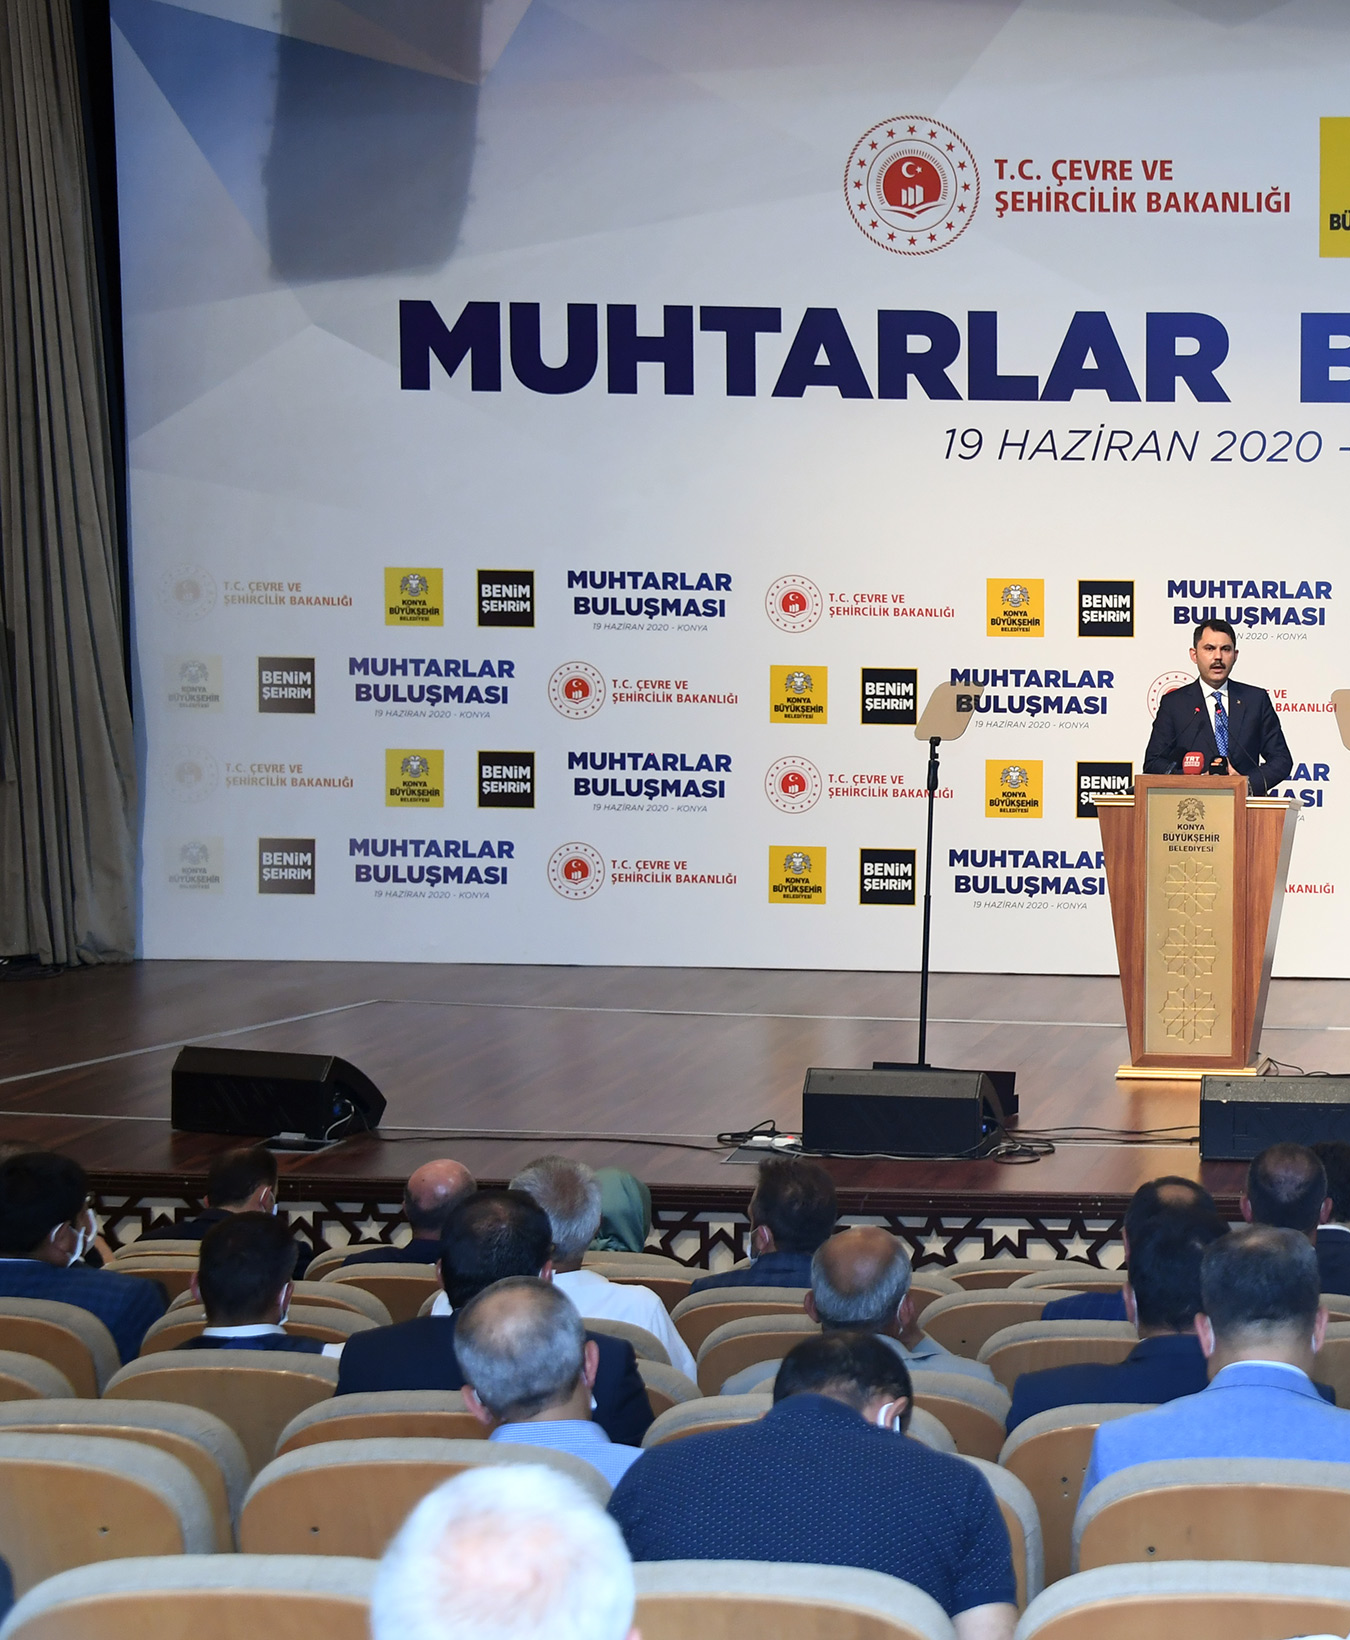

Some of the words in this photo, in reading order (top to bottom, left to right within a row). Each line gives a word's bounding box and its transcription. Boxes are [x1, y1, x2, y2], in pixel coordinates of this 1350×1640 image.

[994, 159, 1041, 180] T.C.
[1052, 160, 1132, 183] ÇEVRE
[1142, 160, 1173, 180] VE
[995, 185, 1136, 217] ŞEHİRCİLİK
[1147, 186, 1290, 213] BAKANLIĞI
[399, 300, 1231, 402] MUHTARLAR
[946, 429, 982, 460] 19
[998, 423, 1199, 461] HAZİRAN
[1211, 431, 1322, 462] 2020
[568, 570, 732, 591] MUHTARLAR
[1168, 580, 1332, 600] MUHTARLAR
[574, 595, 725, 619] BULUŞMASI
[829, 593, 849, 602] T.C.
[853, 593, 887, 605] ÇEVRE
[891, 594, 904, 603] VE
[829, 604, 889, 618] ŞEHİRCİLİK
[894, 607, 954, 617] BAKANLIĞI
[349, 658, 514, 678] MUHTARLAR
[612, 680, 632, 689] T.C.
[636, 680, 671, 692] ÇEVRE
[675, 681, 688, 690] VE
[951, 669, 1114, 688] MUHTARLAR
[355, 683, 508, 706] BULUŞMASI
[612, 692, 672, 704] ŞEHİRCİLİK
[677, 693, 737, 704] BAKANLIĞI
[1274, 689, 1287, 699] VE
[957, 694, 1107, 716] BULUŞMASI
[1275, 701, 1337, 713] BAKANLIĞI
[986, 720, 1026, 728] HAZİRAN
[568, 752, 732, 773] MUHTARLAR
[575, 777, 725, 801] BULUŞMASI
[829, 774, 849, 783] T.C.
[852, 774, 886, 786] ÇEVRE
[890, 775, 903, 784] VE
[829, 786, 888, 798] ŞEHİRCİLİK
[349, 839, 514, 859] MUHTARLAR
[355, 864, 508, 887] BULUŞMASI
[611, 860, 631, 869] T.C.
[635, 860, 670, 872] ÇEVRE
[674, 861, 687, 870] VE
[612, 872, 671, 885] ŞEHİRCİLİK
[676, 873, 736, 884] BAKANLIĞI
[955, 875, 1105, 898] BULUŞMASI
